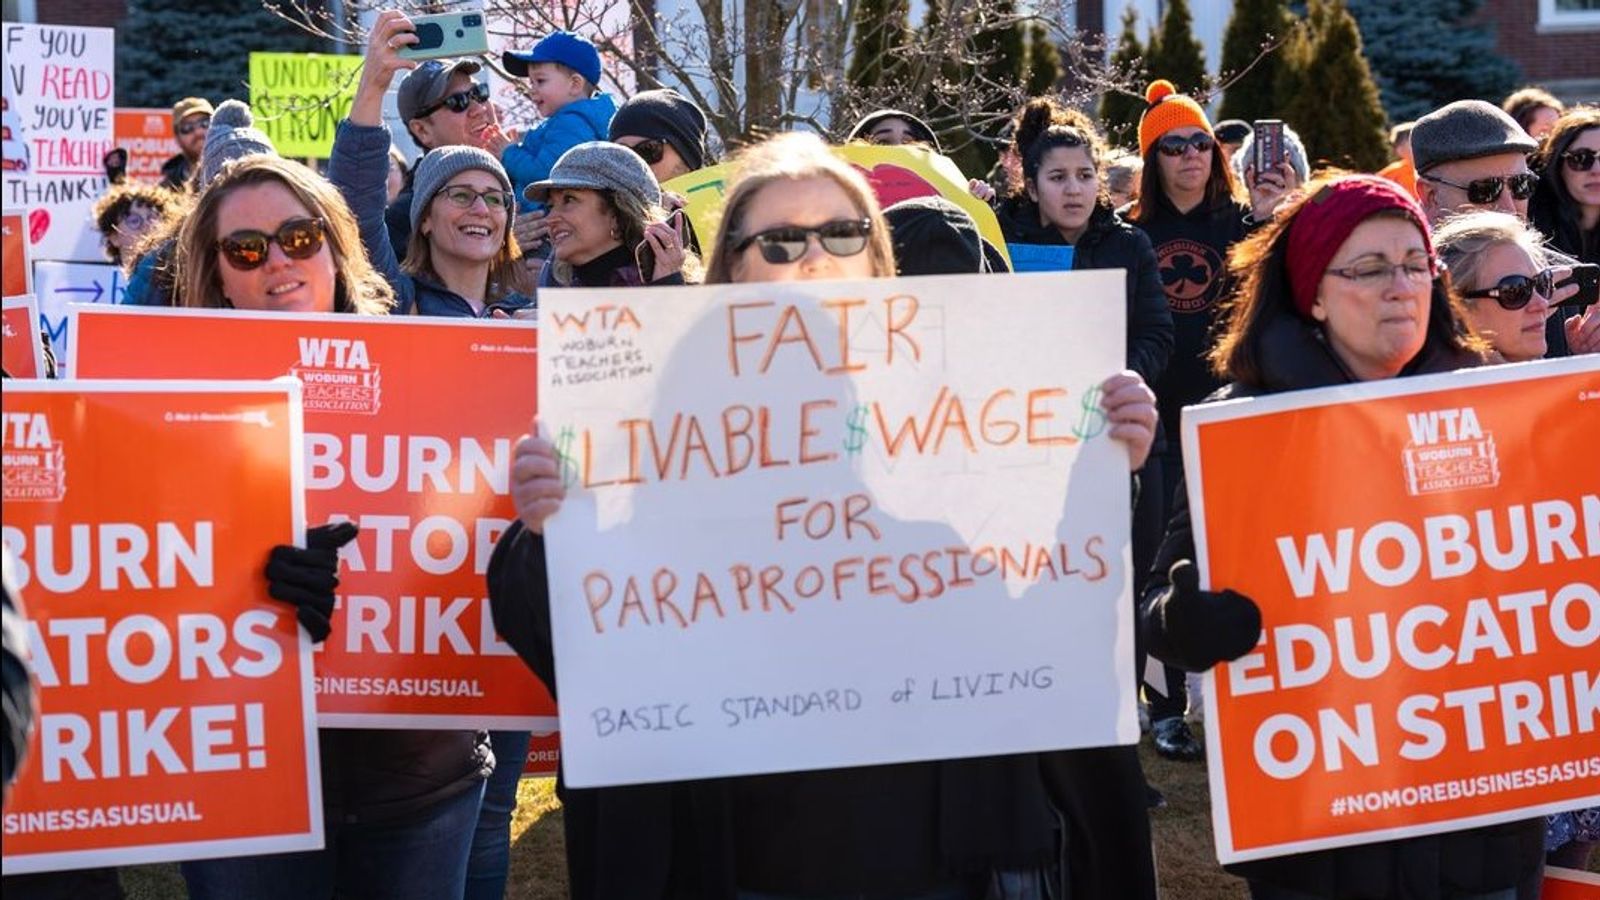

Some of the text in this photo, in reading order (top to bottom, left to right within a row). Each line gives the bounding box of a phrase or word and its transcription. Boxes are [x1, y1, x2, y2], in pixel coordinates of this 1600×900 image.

[40, 28, 86, 58] YOU
[41, 65, 111, 101] READ
[261, 59, 341, 88] UNION
[32, 105, 107, 132] YOU'VE
[551, 303, 642, 332] WTA
[560, 336, 634, 352] WOBURN
[727, 294, 921, 376] FAIR
[298, 337, 371, 370] WTA
[550, 350, 642, 371] TEACHERS
[303, 372, 357, 385] WOBURN
[2, 412, 52, 449] TA
[1407, 407, 1483, 446] WTA
[1418, 446, 1473, 463] WOBURN
[775, 494, 881, 542] FOR
[582, 535, 1109, 634] PARAPROFESSIONALS
[592, 665, 1055, 738] BASIC STANDARD of LIVING
[527, 749, 560, 763] ORE
[1252, 703, 1380, 781] ON
[1331, 756, 1600, 817] #NOMOREBUSINESSASUS
